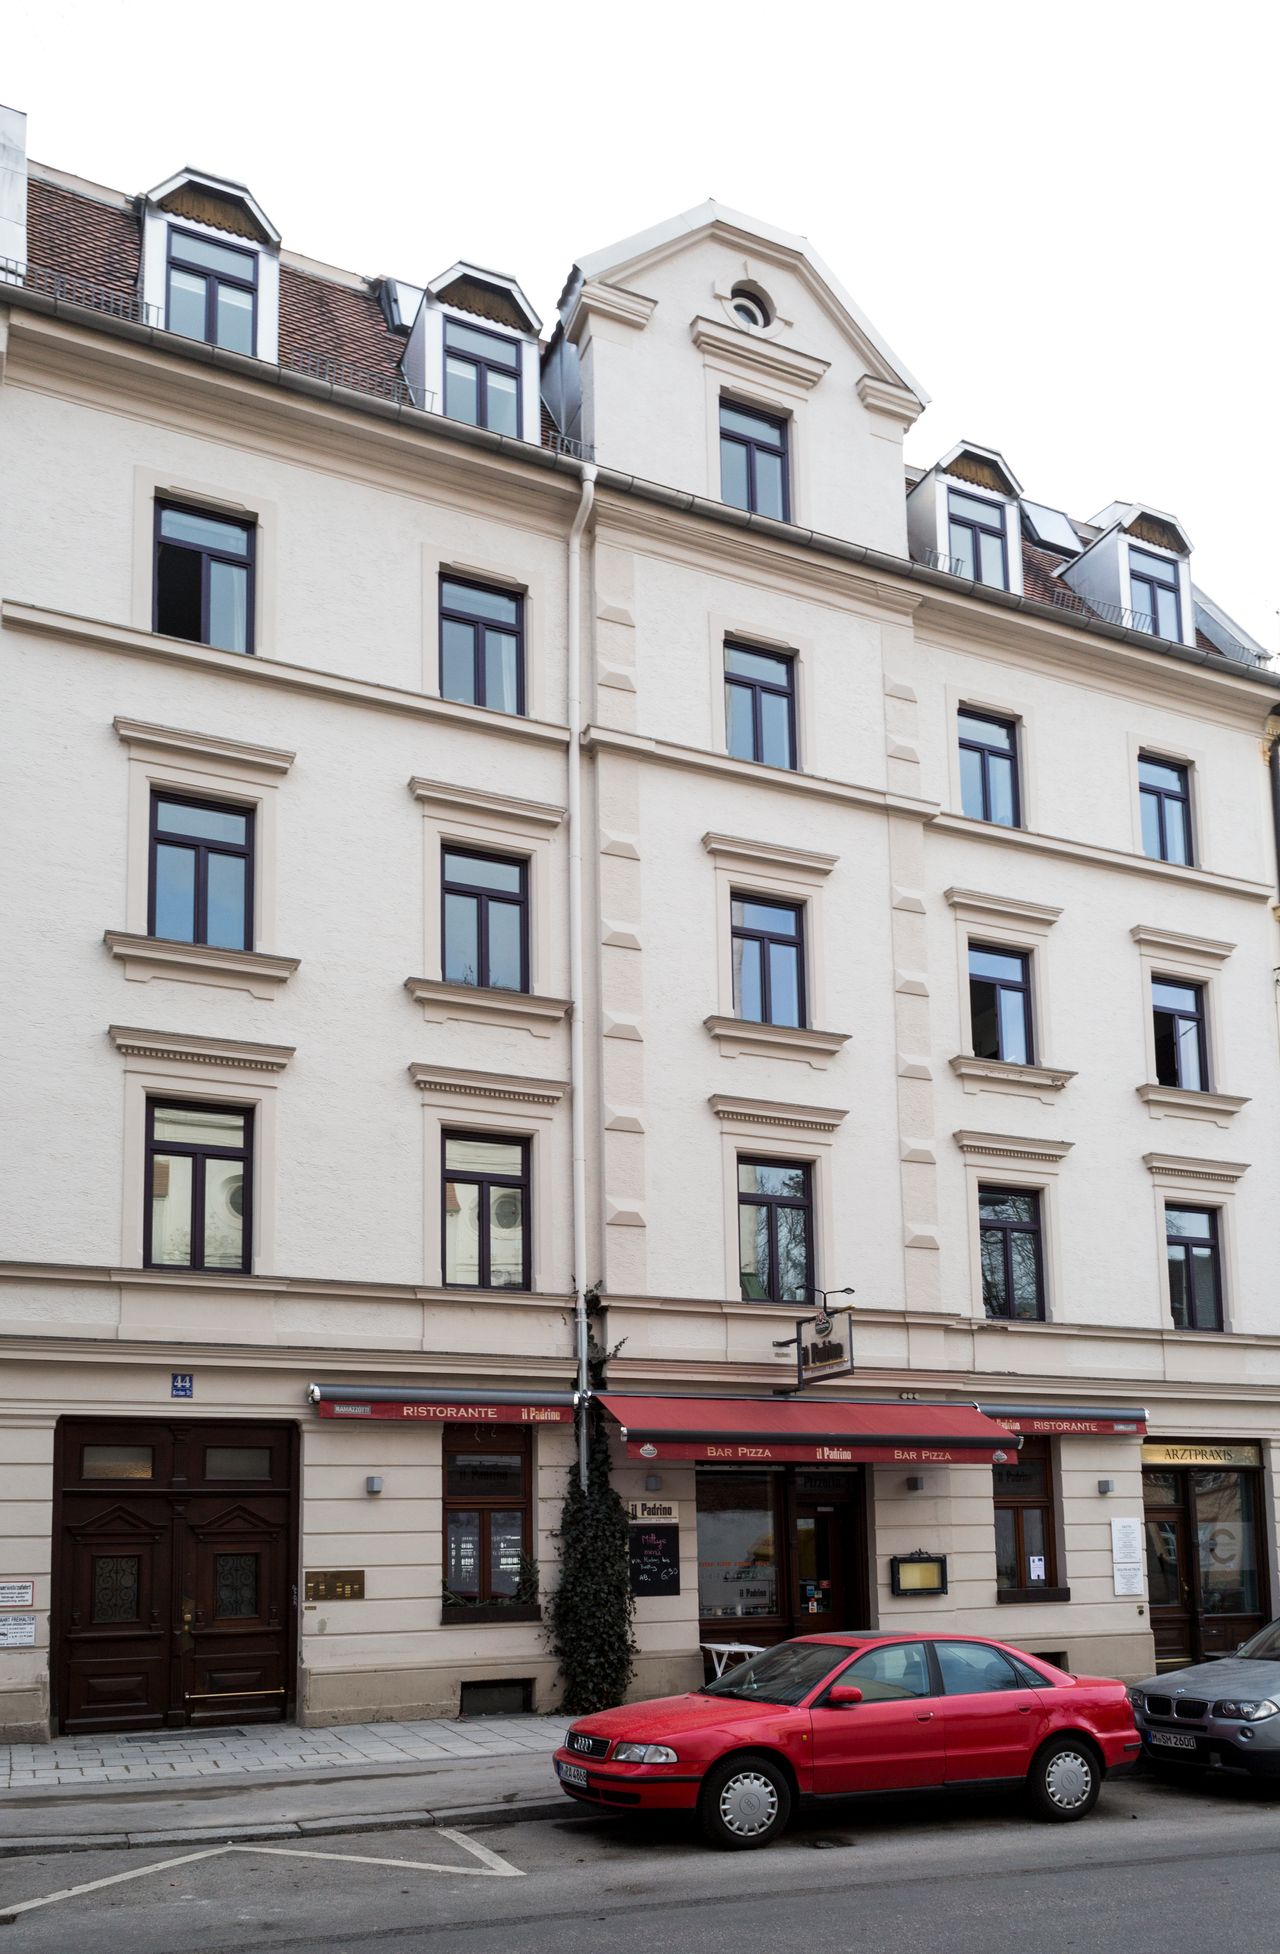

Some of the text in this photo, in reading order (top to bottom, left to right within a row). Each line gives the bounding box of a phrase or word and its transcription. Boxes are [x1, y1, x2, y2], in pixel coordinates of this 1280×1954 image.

[174, 1376, 191, 1388] 44
[403, 1406, 561, 1421] RISTORANTE il Padrino
[1034, 1421, 1098, 1431] RISTORANTE
[816, 1448, 823, 1459] il
[824, 1447, 852, 1460] Padrino
[1164, 1448, 1234, 1461] ARZTPRAXIS
[641, 1503, 673, 1512] Padrino
